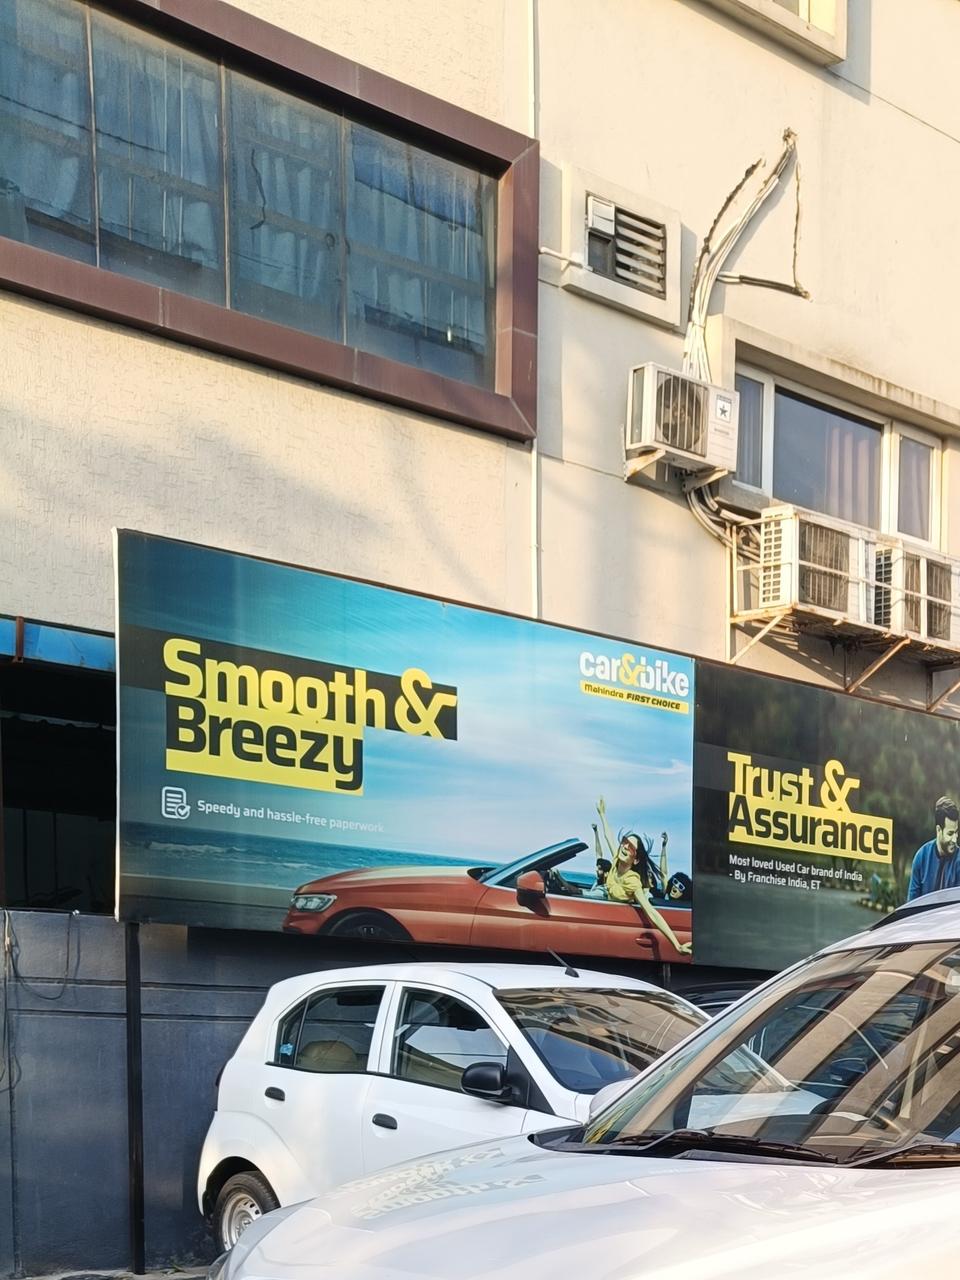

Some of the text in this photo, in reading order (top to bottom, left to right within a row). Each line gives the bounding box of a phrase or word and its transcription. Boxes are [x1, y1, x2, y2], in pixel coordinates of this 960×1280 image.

[162, 637, 457, 739] Smooth &
[579, 651, 690, 697] car&bike
[584, 683, 681, 710] Mahindra FIRST CHOICE
[165, 693, 364, 791] Breezy
[727, 751, 861, 813] Trust &
[197, 799, 385, 833] Speedy and hassle-free paperwork
[729, 793, 890, 857] Assurance
[729, 854, 863, 882] Most loved Used Car brand of India
[734, 870, 746, 883] By
[747, 871, 786, 886] Franchise
[788, 876, 810, 890] India,
[811, 881, 821, 890] ET
